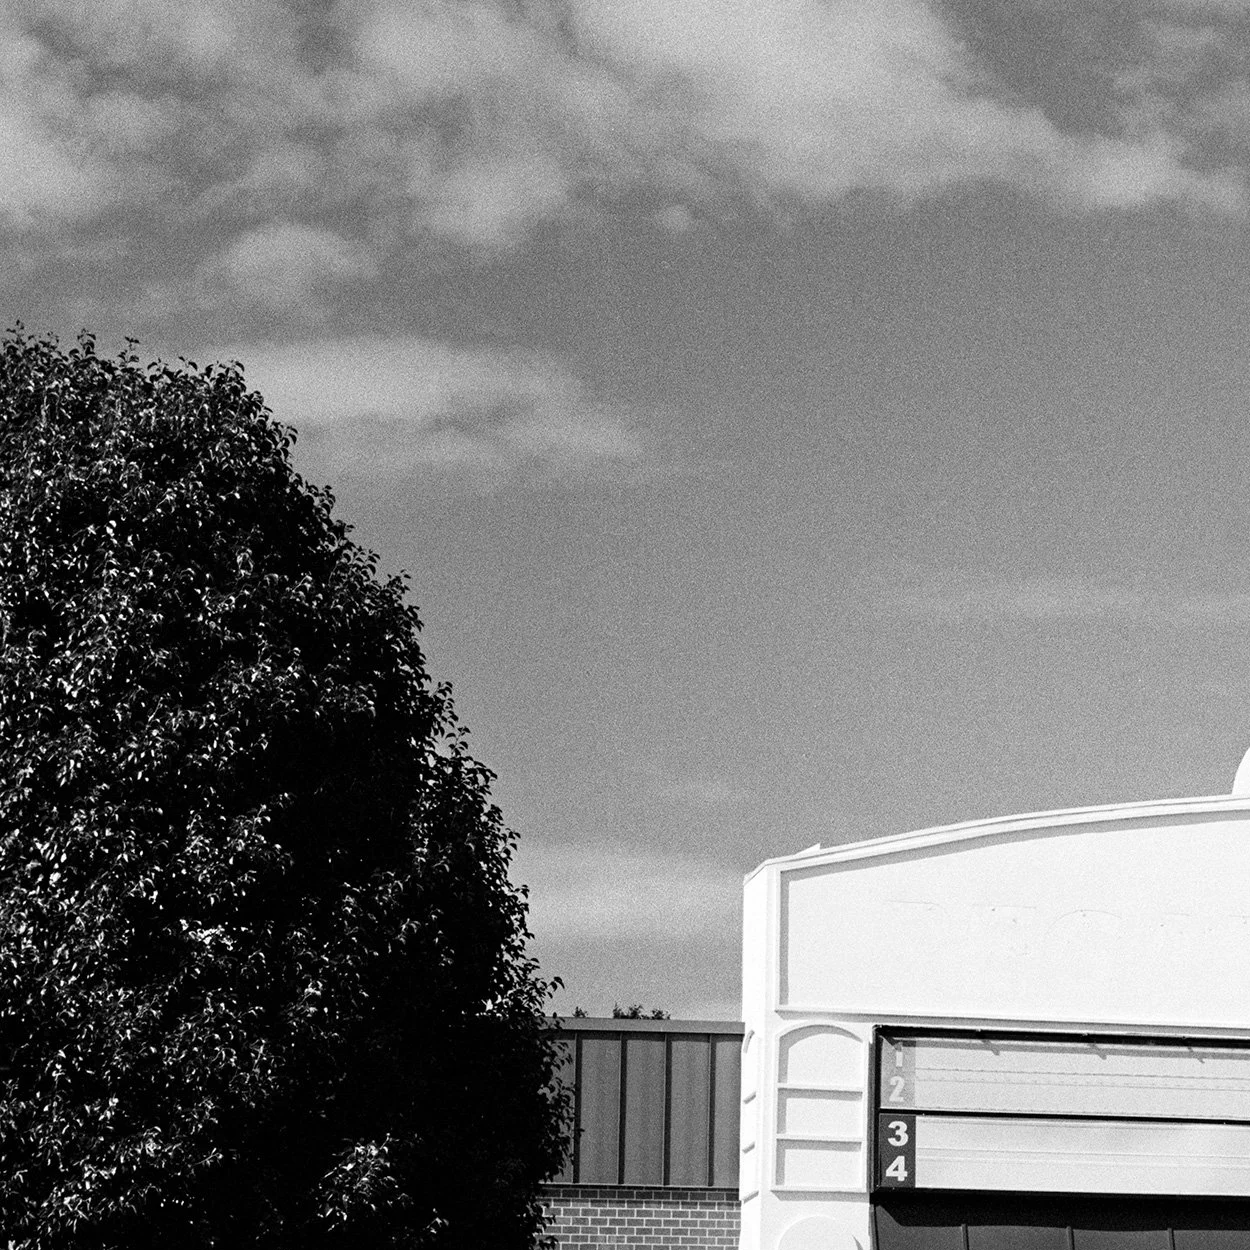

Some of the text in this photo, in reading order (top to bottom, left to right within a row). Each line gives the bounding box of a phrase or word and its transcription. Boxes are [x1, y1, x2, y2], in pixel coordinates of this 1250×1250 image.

[889, 1076, 905, 1102] 2
[887, 1121, 909, 1147] 3
[885, 1155, 908, 1181] 4
